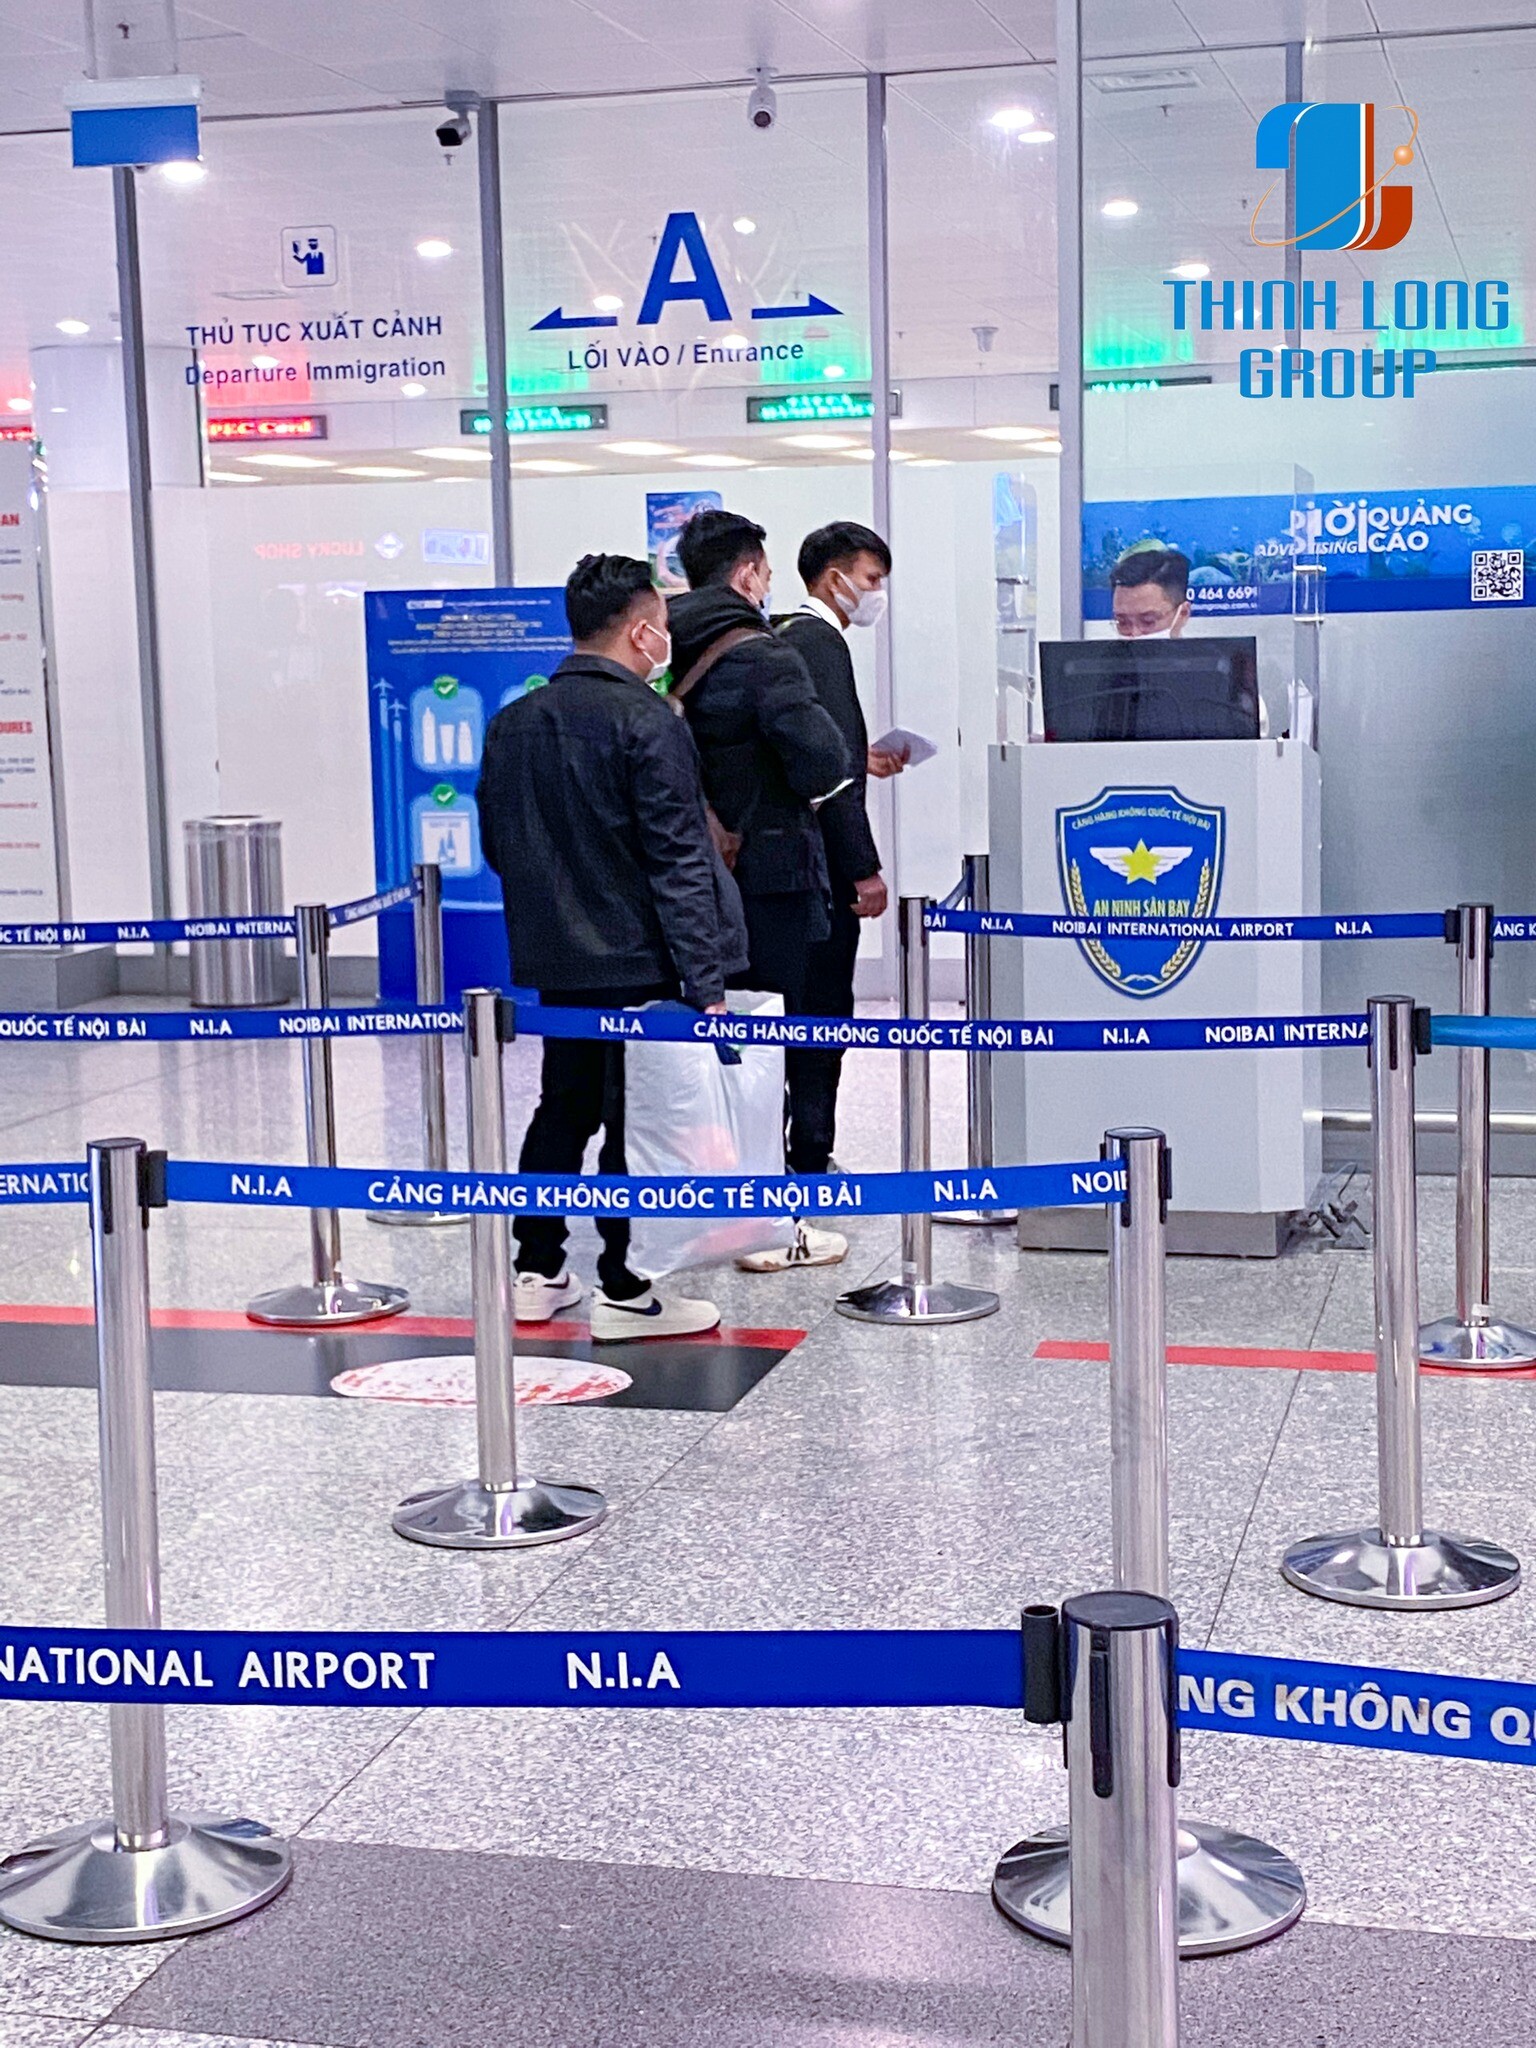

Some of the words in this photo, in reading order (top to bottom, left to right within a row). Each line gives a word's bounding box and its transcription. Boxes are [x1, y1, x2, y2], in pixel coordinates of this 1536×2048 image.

[637, 212, 733, 325] A
[186, 318, 234, 346] THỦ
[242, 323, 292, 347] TỤC
[300, 311, 363, 341] XUẤT
[373, 310, 442, 338] CẢNH
[568, 340, 608, 370] LỐI
[617, 341, 670, 367] VÀO
[693, 343, 804, 364] Entrance
[186, 363, 297, 389] Departure
[306, 358, 446, 384] Immigration
[1368, 498, 1473, 528] QUẢNG
[1368, 527, 1429, 552] CÁO
[1198, 587, 1223, 600] 464
[1093, 900, 1109, 917] AN
[1111, 900, 1140, 917] NINH
[1167, 899, 1190, 917] BAY
[117, 926, 150, 939] N.I.A
[184, 922, 231, 937] NOIBAI
[235, 921, 294, 935] INTERNA
[980, 917, 1014, 931] N.I.A
[1052, 920, 1102, 935] NOIBAI
[1107, 922, 1223, 937] INTERNATIONAL
[1229, 922, 1294, 937] AIRPORT
[1335, 921, 1373, 935] N.I.A
[0, 1014, 49, 1037] QUỐC
[52, 1015, 75, 1037] TẾ
[78, 1017, 110, 1040] NỘI
[116, 1017, 147, 1037] BÀI
[189, 1019, 233, 1036] N.I.A
[279, 1016, 341, 1034] NOIBAI
[600, 1016, 644, 1034] N.I.A
[693, 1016, 747, 1039] CẢNG
[812, 1023, 880, 1044] KHÔNG
[887, 1022, 943, 1045] QUỐC
[948, 1023, 974, 1045] TẾ
[977, 1025, 1013, 1049] NỘI
[1020, 1026, 1054, 1046] BÀI
[1103, 1027, 1150, 1045] N.I.A
[1205, 1024, 1275, 1044] NOIBAI
[231, 1174, 293, 1198] N.I.A
[368, 1175, 443, 1205] CẢNG
[536, 1182, 630, 1209] KHÔNG
[637, 1179, 715, 1210] QUỐC
[723, 1179, 756, 1209] TẾ
[762, 1181, 810, 1213] NỘI
[817, 1180, 862, 1207] BÀI
[933, 1178, 999, 1202] N.I.A
[238, 1651, 435, 1690] AIRPORT
[566, 1651, 681, 1689] N.I.A
[1275, 1681, 1471, 1740] KHÔNG
